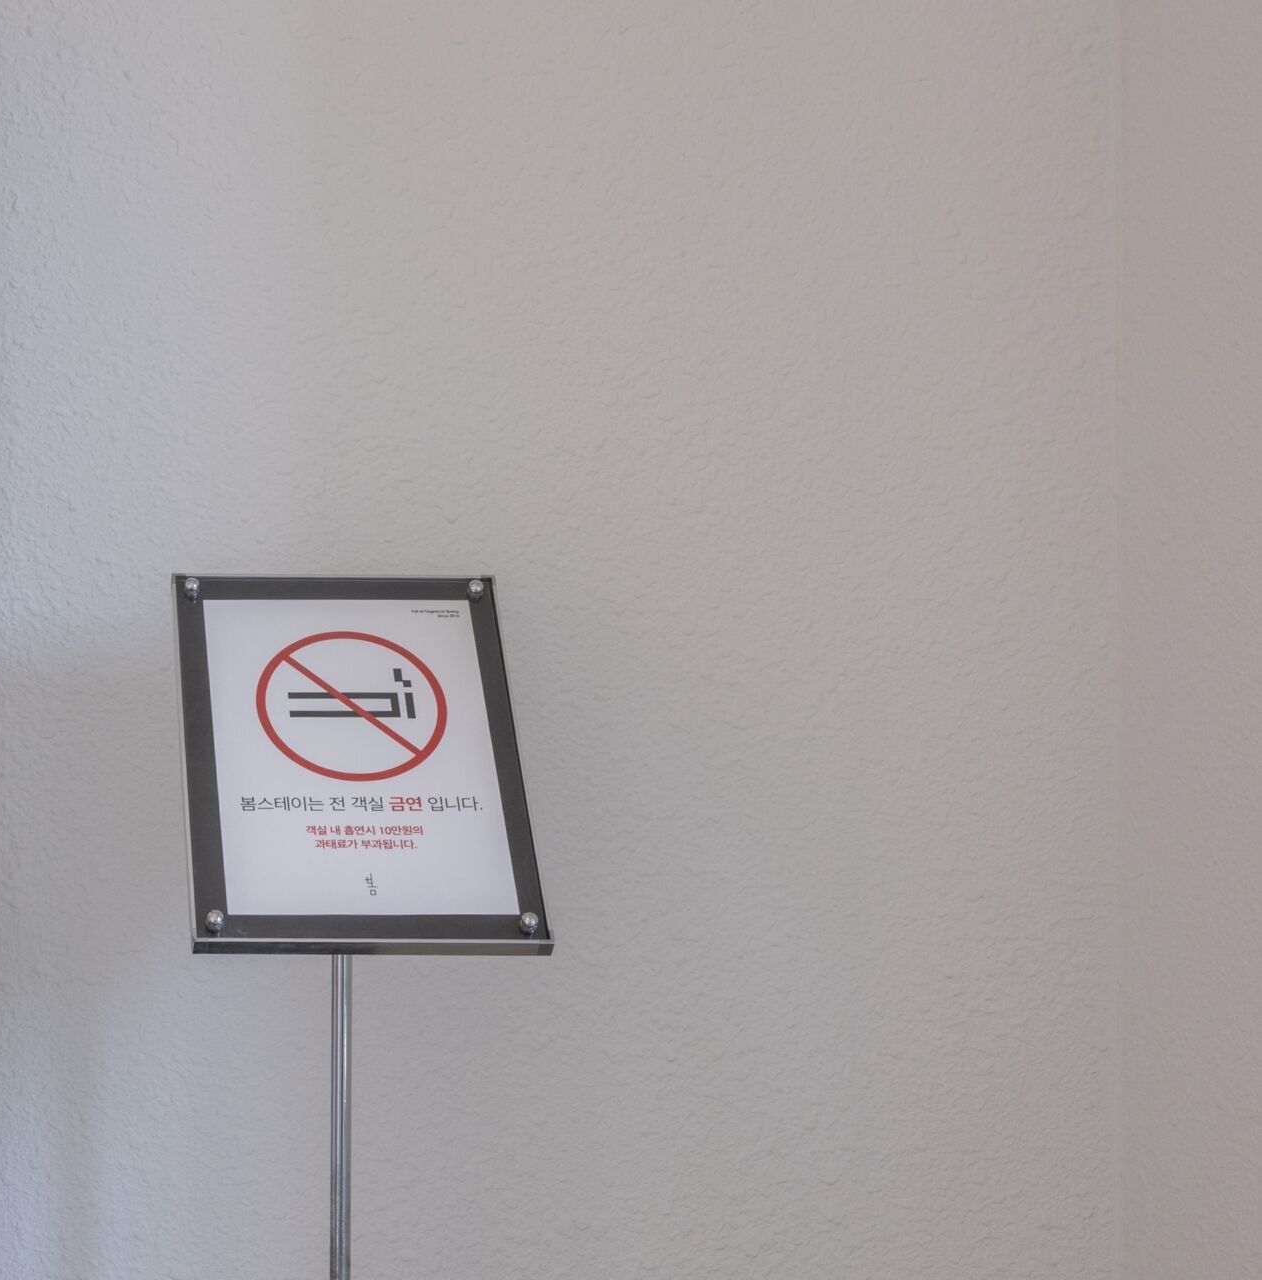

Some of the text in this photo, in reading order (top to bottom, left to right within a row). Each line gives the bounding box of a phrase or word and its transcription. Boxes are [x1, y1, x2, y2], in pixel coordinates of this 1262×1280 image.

[240, 796, 482, 811] 봄스테이는 전 객실 금연 입니다.
[305, 824, 424, 836] 객실 내 흡연시 10만원의
[315, 839, 418, 850] 과태료가 부과됩니다.
